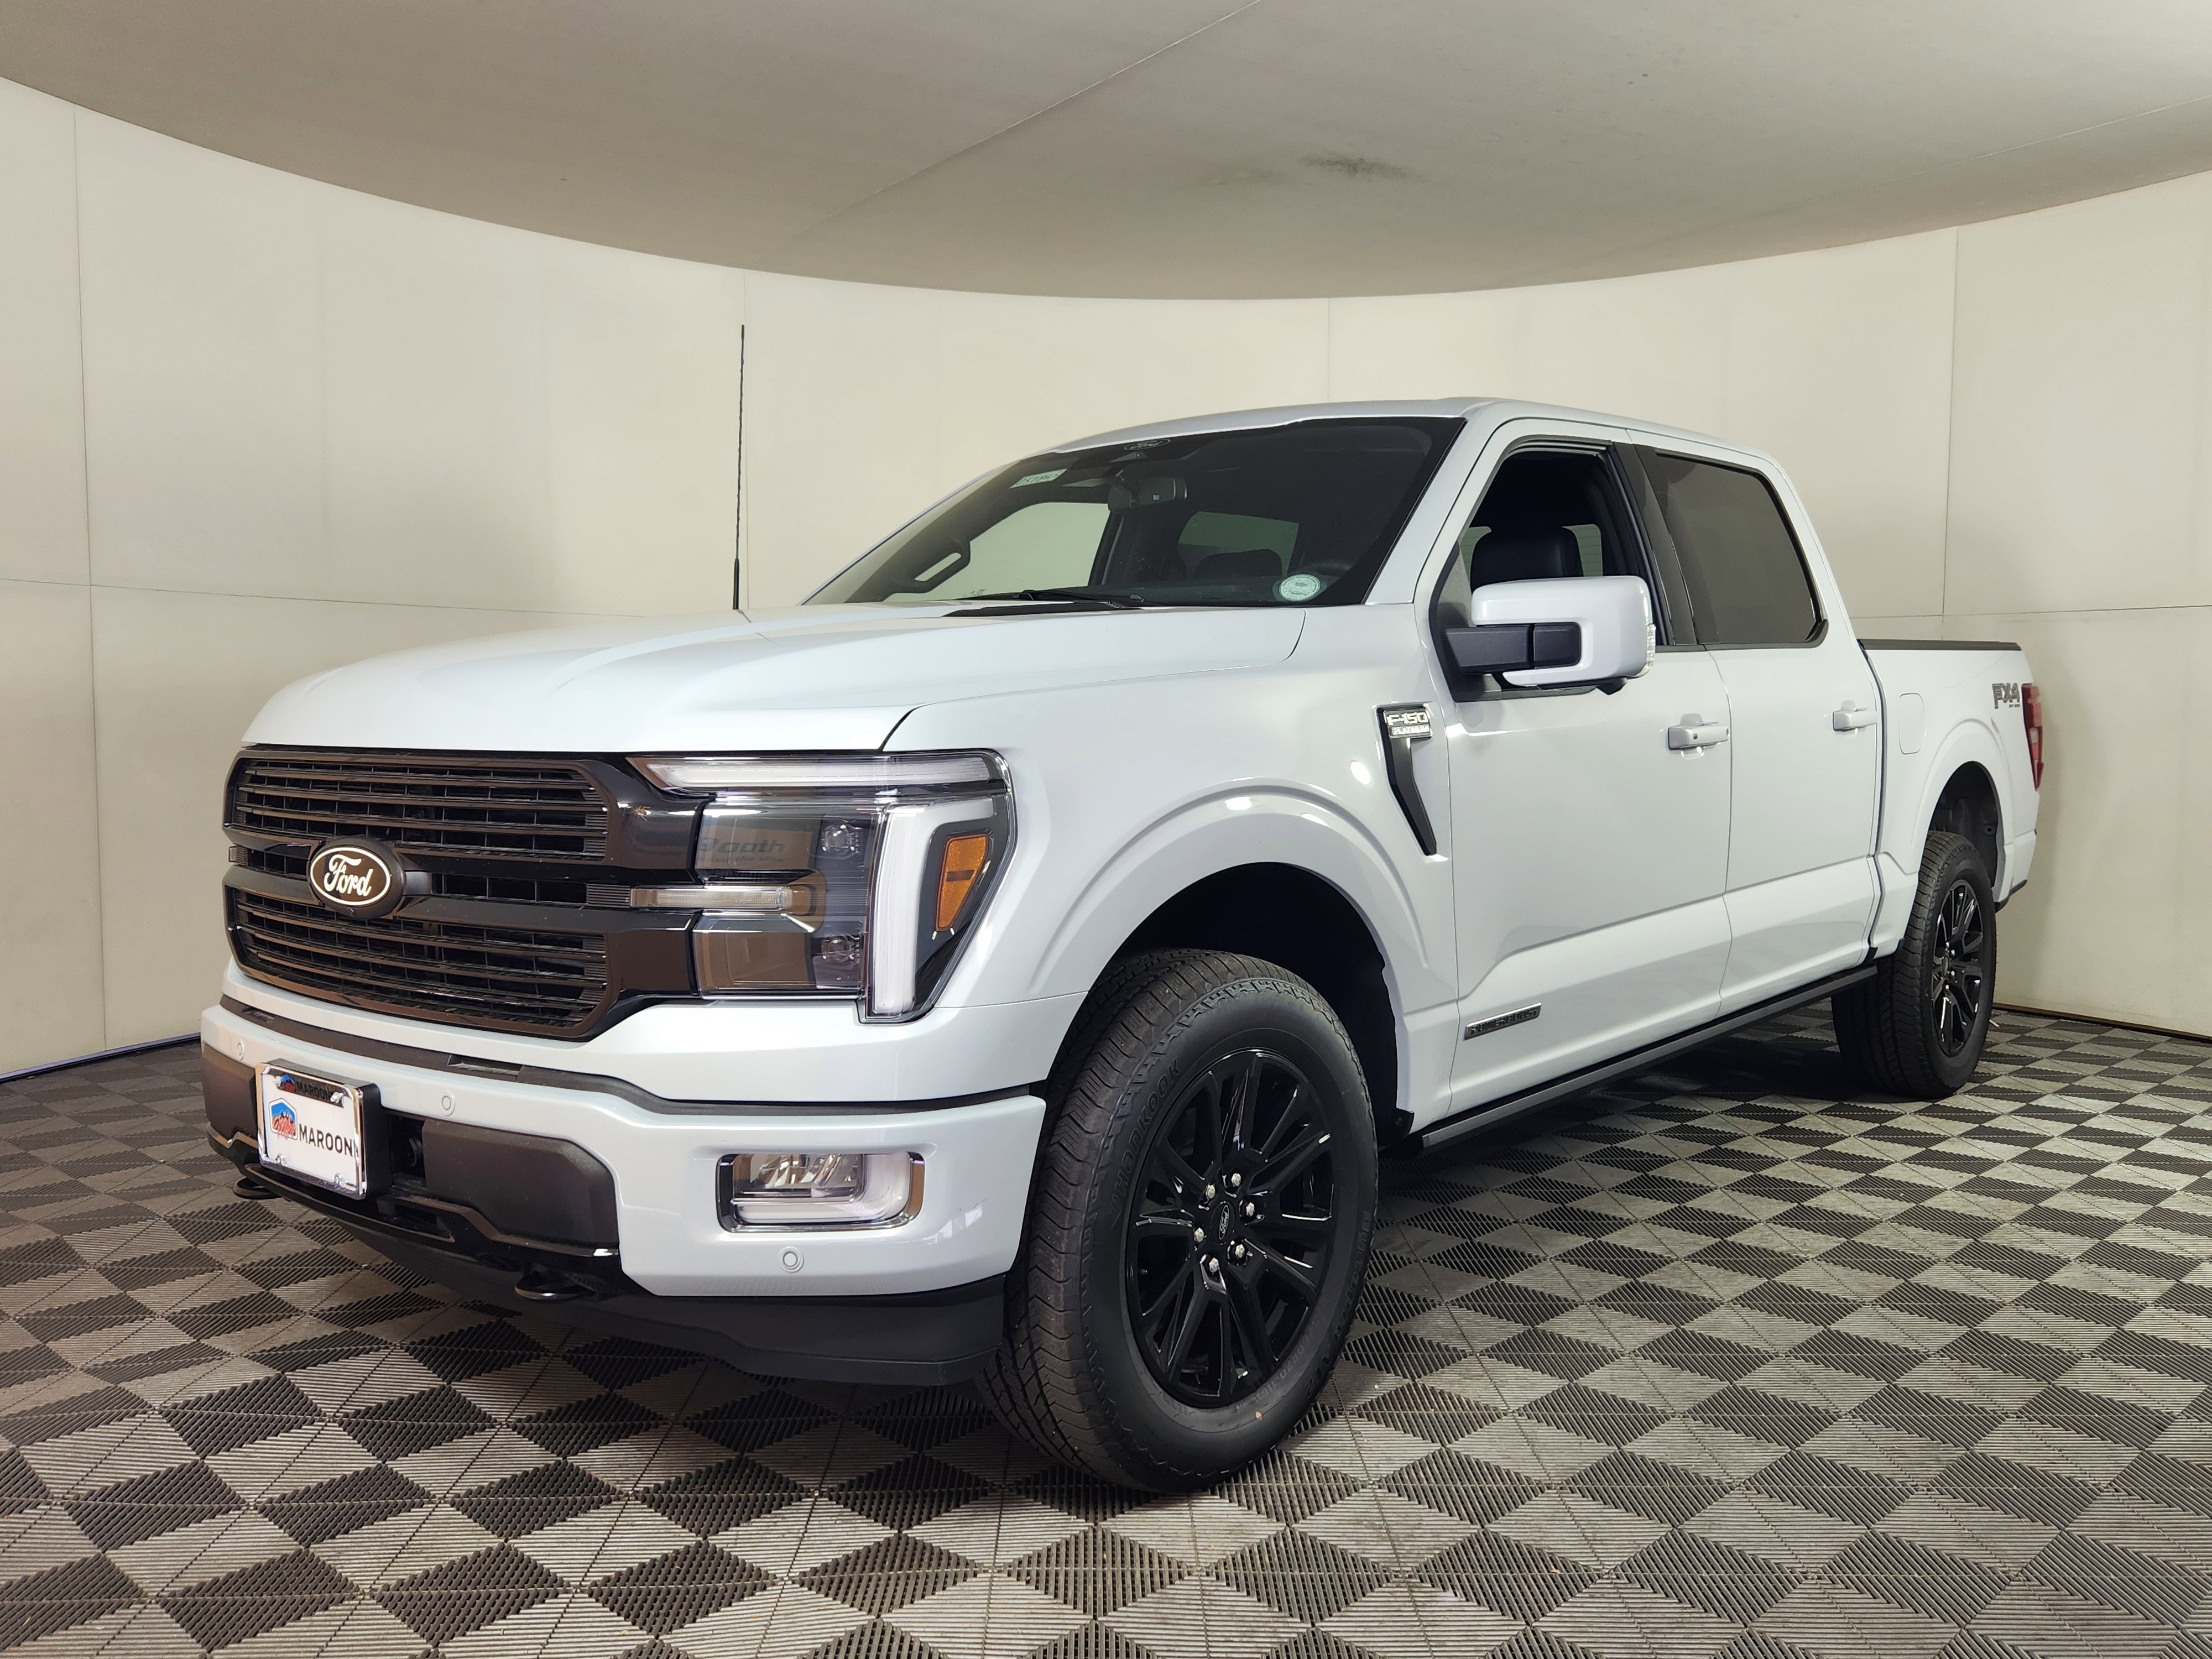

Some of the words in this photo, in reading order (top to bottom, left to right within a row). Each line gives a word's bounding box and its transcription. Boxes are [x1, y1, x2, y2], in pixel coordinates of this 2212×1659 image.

[1992, 682, 2020, 709] FX4
[1386, 712, 1428, 725] F-150
[324, 854, 373, 896] Ford
